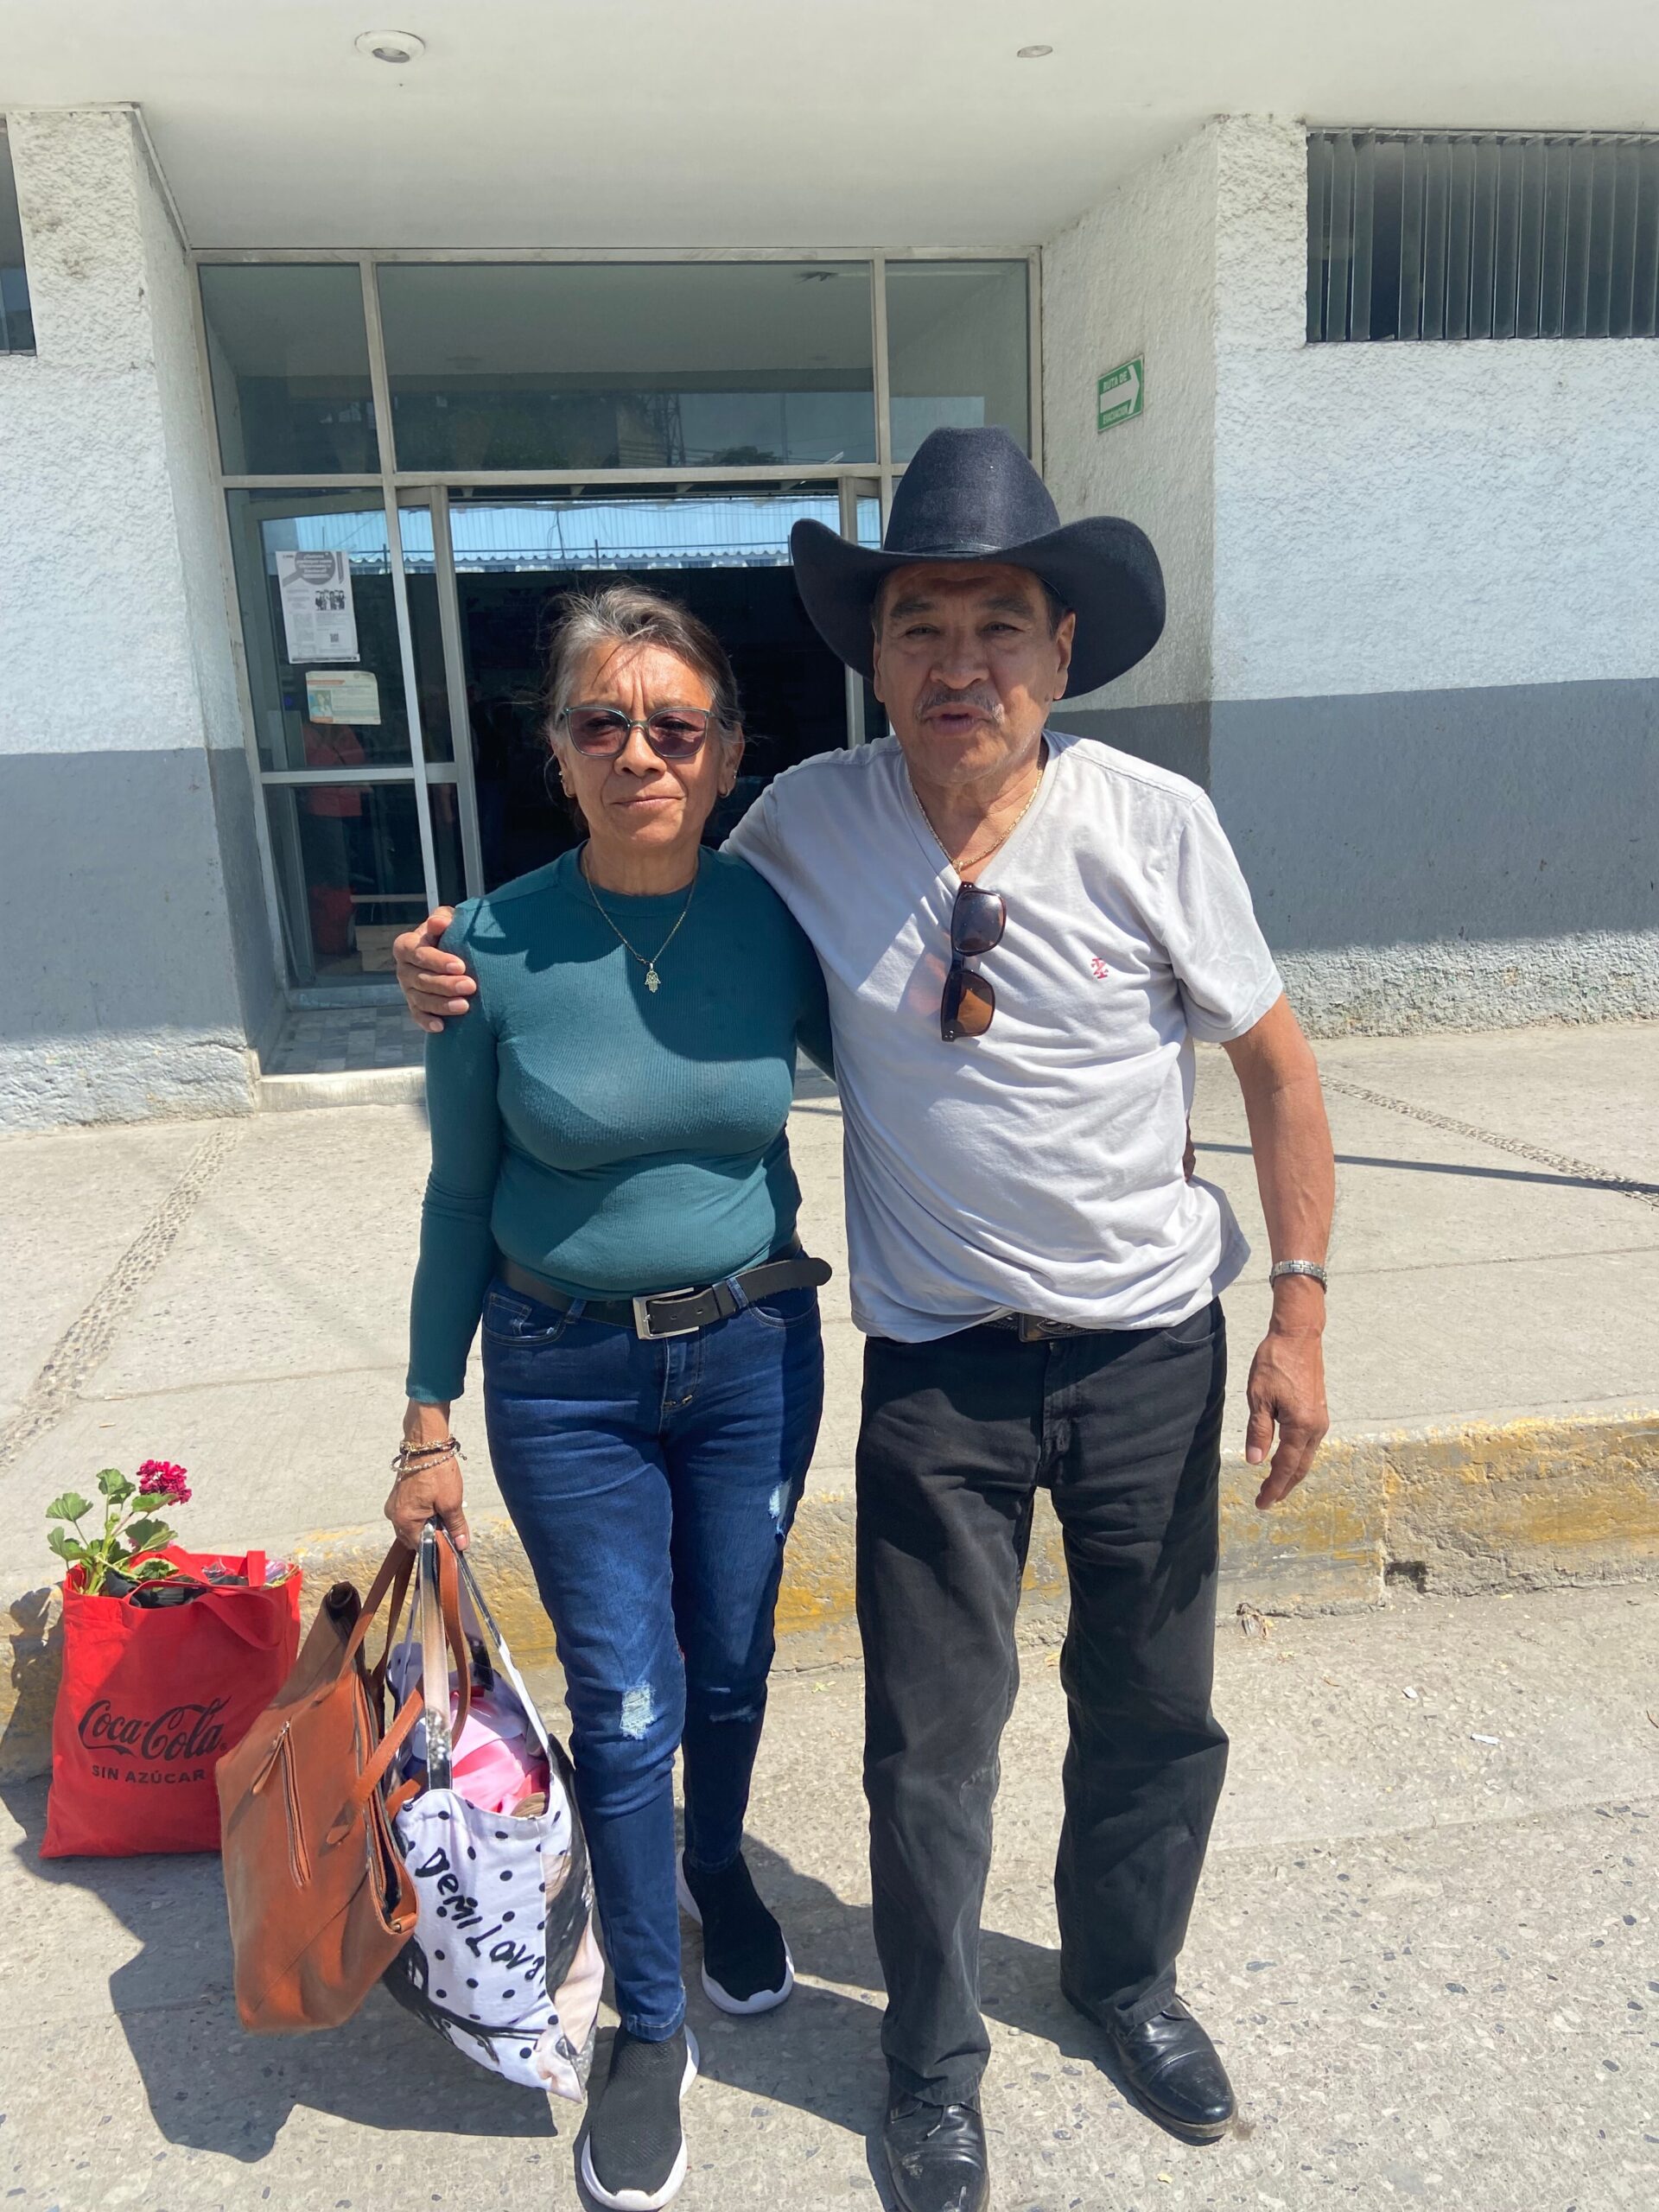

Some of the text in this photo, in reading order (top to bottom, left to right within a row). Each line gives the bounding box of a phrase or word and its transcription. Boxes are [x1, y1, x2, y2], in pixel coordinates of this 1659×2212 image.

[1103, 371, 1128, 392] RUTA DE
[78, 1694, 232, 1761] Coca-Cola
[92, 1764, 206, 1784] SIN AZÚCAR
